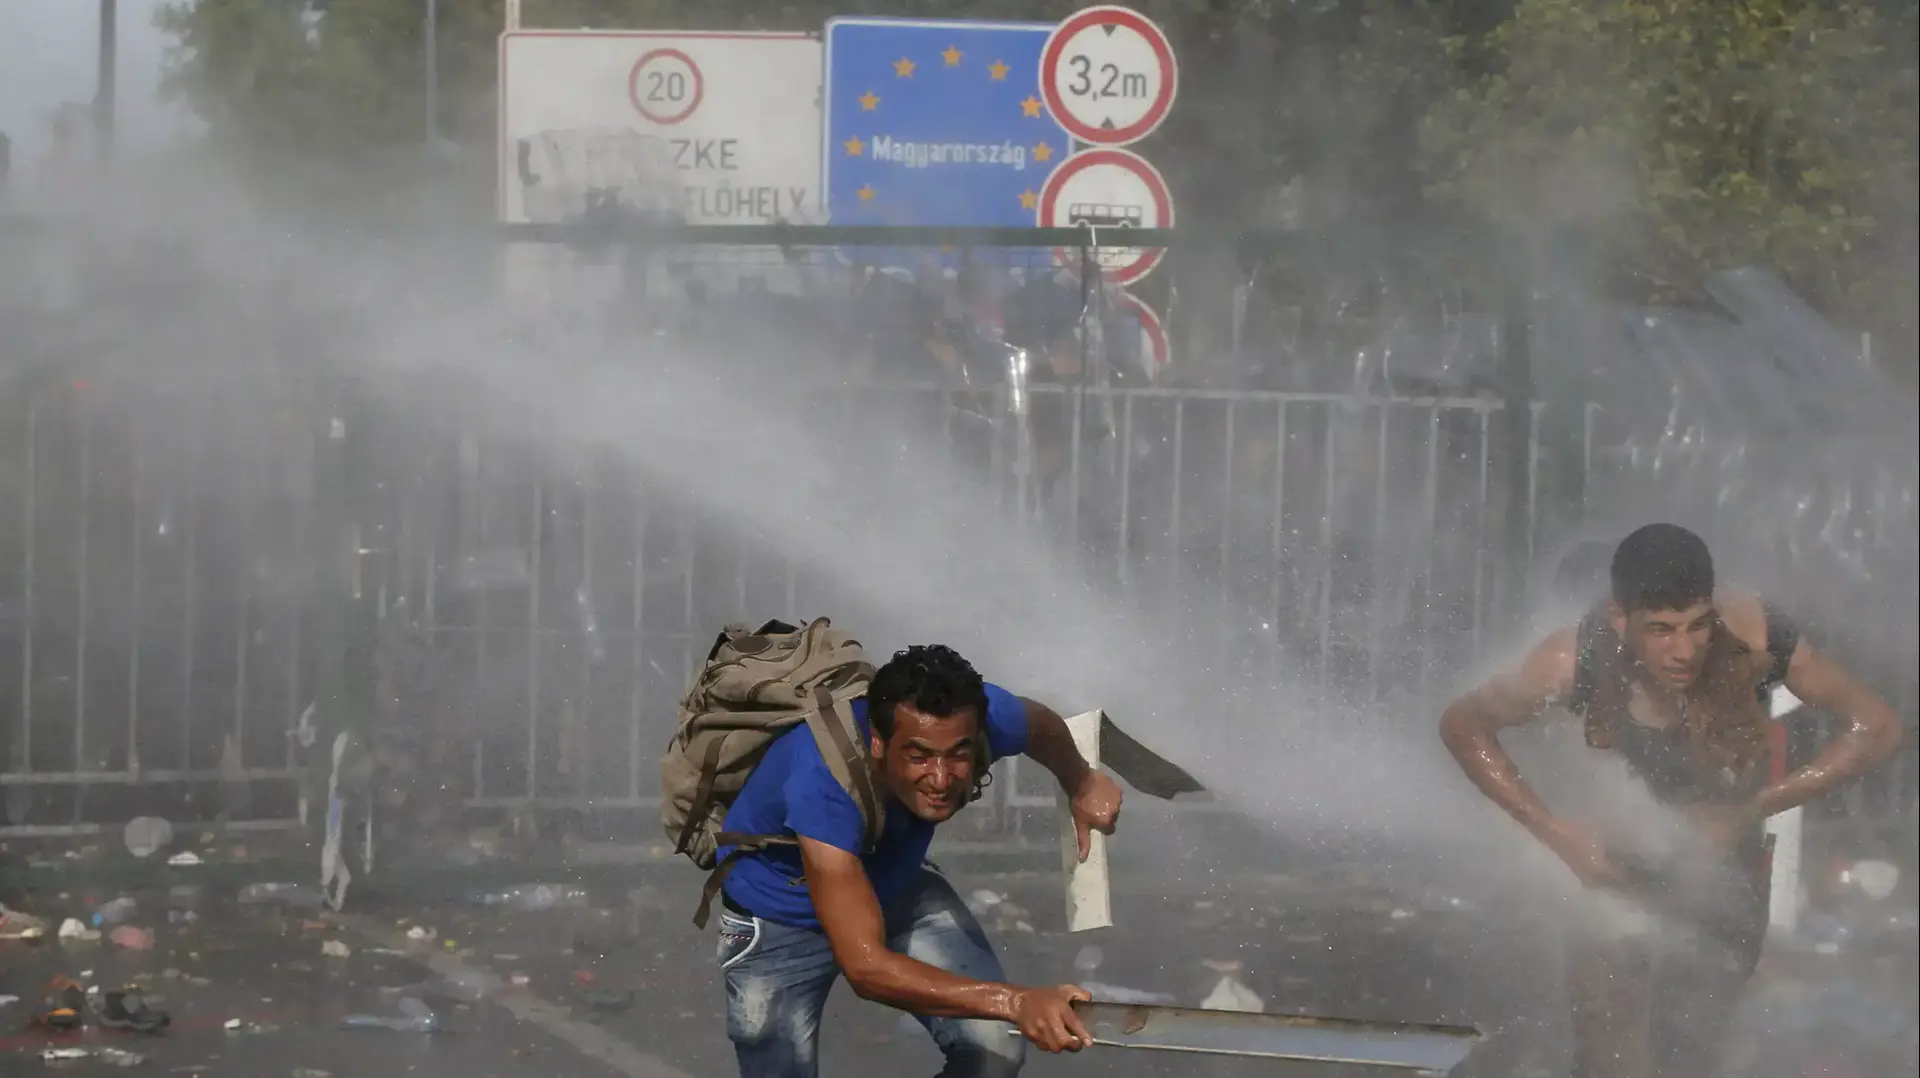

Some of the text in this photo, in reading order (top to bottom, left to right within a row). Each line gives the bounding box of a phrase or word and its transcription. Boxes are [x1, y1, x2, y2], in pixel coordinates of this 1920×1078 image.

[647, 72, 685, 102] 20
[669, 138, 739, 170] ZKE
[872, 135, 1026, 170] Magyarország
